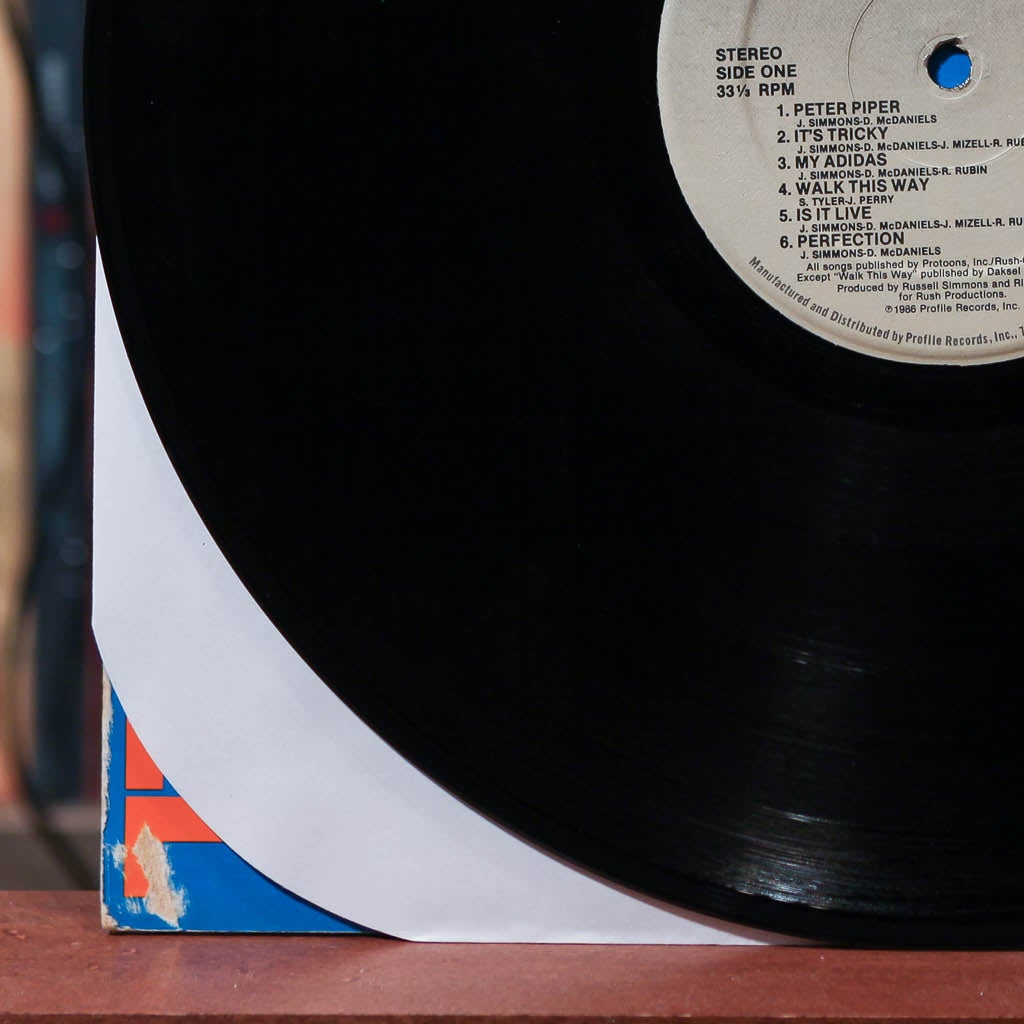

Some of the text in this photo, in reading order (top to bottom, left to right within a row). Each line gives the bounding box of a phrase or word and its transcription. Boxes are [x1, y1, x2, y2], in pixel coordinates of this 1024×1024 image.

[716, 46, 782, 61] STEREO
[716, 64, 797, 80] SIDE ONE
[759, 83, 795, 96] RPM
[777, 100, 900, 116] 1. PETER PIPER
[797, 115, 937, 128] J. SIMMONS-D. McDANIELS
[777, 127, 888, 143] 2. IT'S TRICKY
[798, 146, 806, 154] J.
[810, 144, 874, 154] SIMMONS-D.
[878, 140, 949, 151] McDANIELS-J.
[952, 140, 1002, 148] MIZELL-R.
[778, 154, 887, 169] 3. MY ADIDAS
[798, 166, 988, 180] J. SIMMONS-D. McDANIELS-R. RUBIN
[778, 178, 930, 196] 4. WALK THIS WAY
[799, 195, 894, 206] S. TYLER-J. PERRY
[779, 206, 872, 222] 5. IS IT LIVE
[800, 224, 808, 233] J.
[812, 222, 876, 232] SIMMONS-D.
[880, 220, 950, 230] McDANIELS-J.
[955, 218, 1005, 228] MIZELL-R.
[780, 232, 904, 248] 6. PERFECTION
[800, 247, 941, 260] J. SIMMONS-D. McDANIELS
[806, 263, 820, 271] All
[823, 263, 852, 272] songs
[856, 260, 904, 270] published
[908, 260, 918, 268] by
[922, 258, 970, 268] Protoons,
[797, 272, 831, 282] Except
[867, 270, 888, 279] This
[920, 268, 969, 279] published
[972, 268, 984, 278] by
[987, 266, 1021, 275] Daksel
[837, 283, 884, 293] Produced
[886, 282, 898, 292] by
[902, 281, 939, 290] Russell
[942, 280, 988, 290] Simmons
[992, 280, 1010, 288] and
[748, 256, 812, 307] Manufactured
[810, 303, 830, 318] and
[830, 310, 890, 341] Distributed
[892, 328, 904, 344] by
[905, 332, 942, 346] Profile
[946, 333, 993, 346] Records,
[899, 290, 1006, 301] for Rush Productions.
[920, 302, 952, 312] Profile
[956, 302, 1000, 312] Records,
[1002, 302, 1020, 310] Inc.
